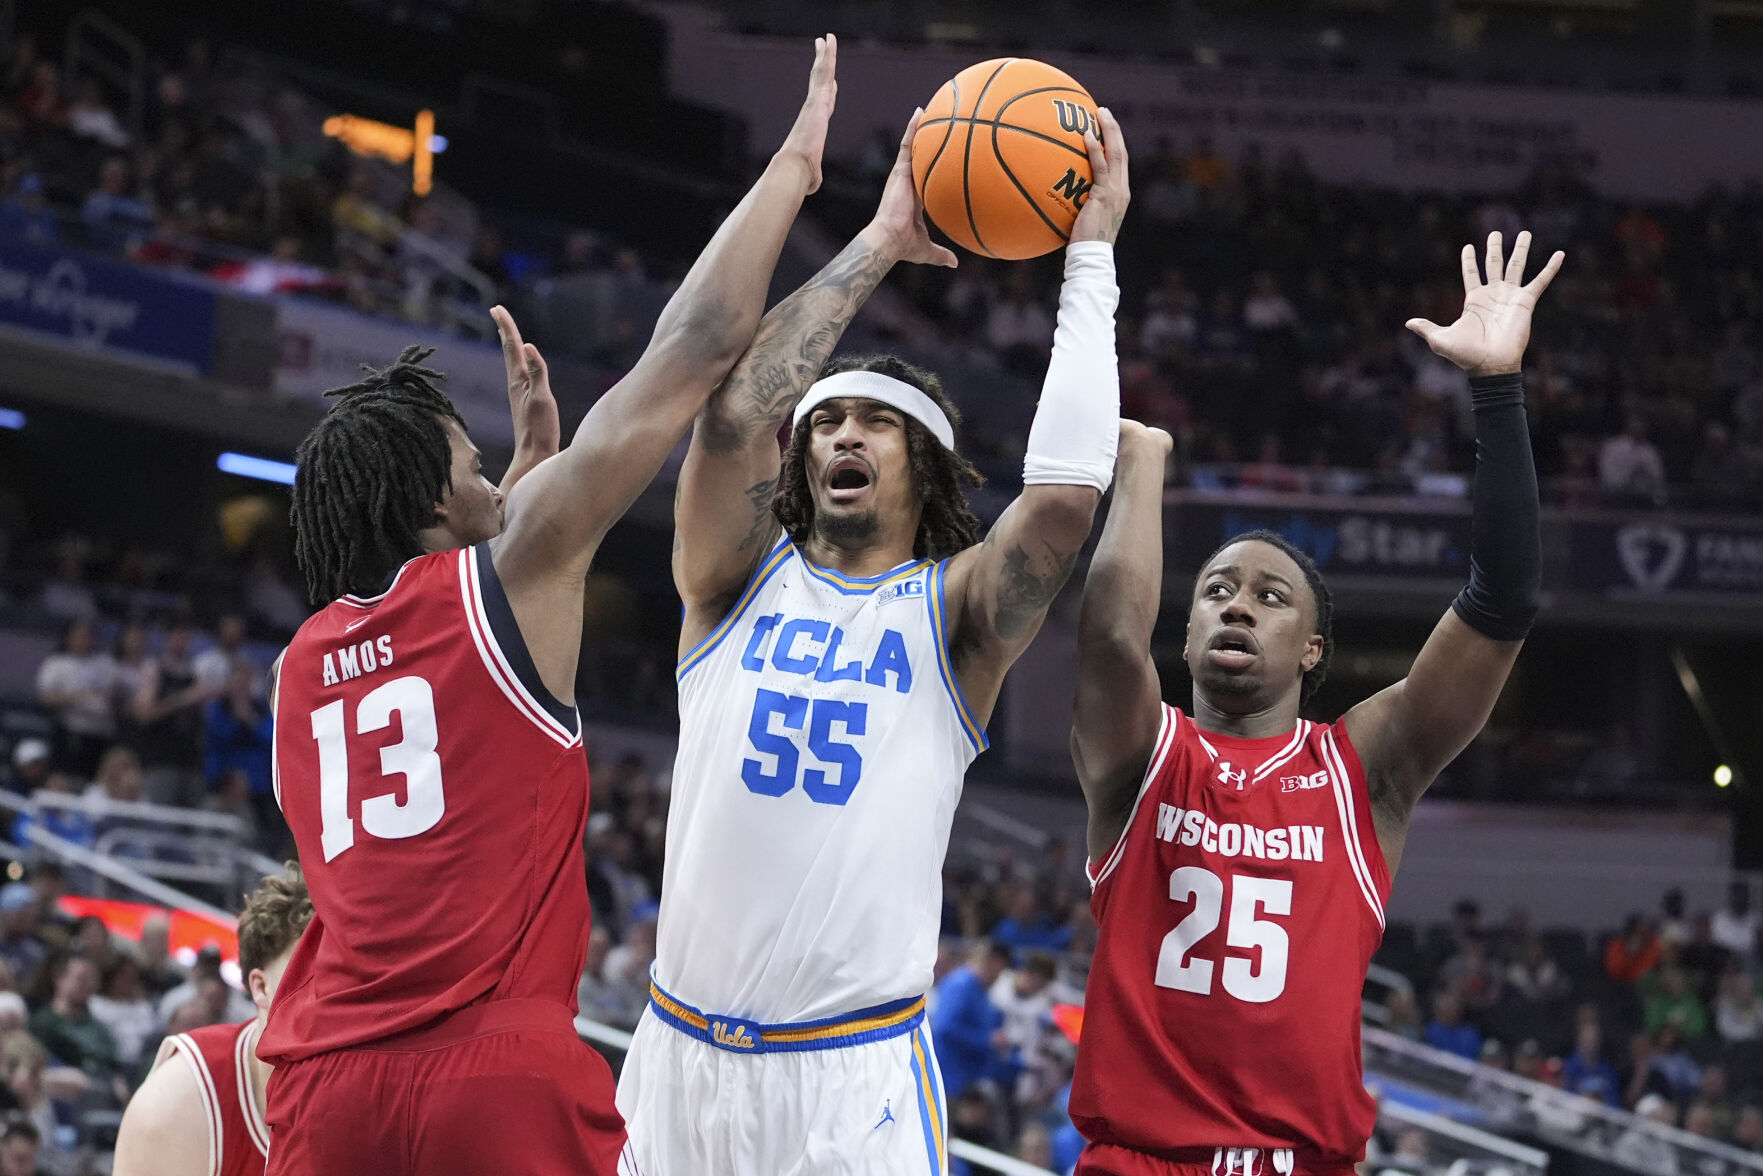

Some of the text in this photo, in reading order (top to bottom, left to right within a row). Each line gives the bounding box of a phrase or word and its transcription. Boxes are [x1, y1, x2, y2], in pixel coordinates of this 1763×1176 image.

[323, 634, 394, 687] AMOS
[310, 676, 446, 864] 13
[741, 688, 868, 806] 55
[1155, 802, 1325, 862] WSCONSIN
[1154, 866, 1294, 1003] 25
[713, 1021, 755, 1048] Ucla
